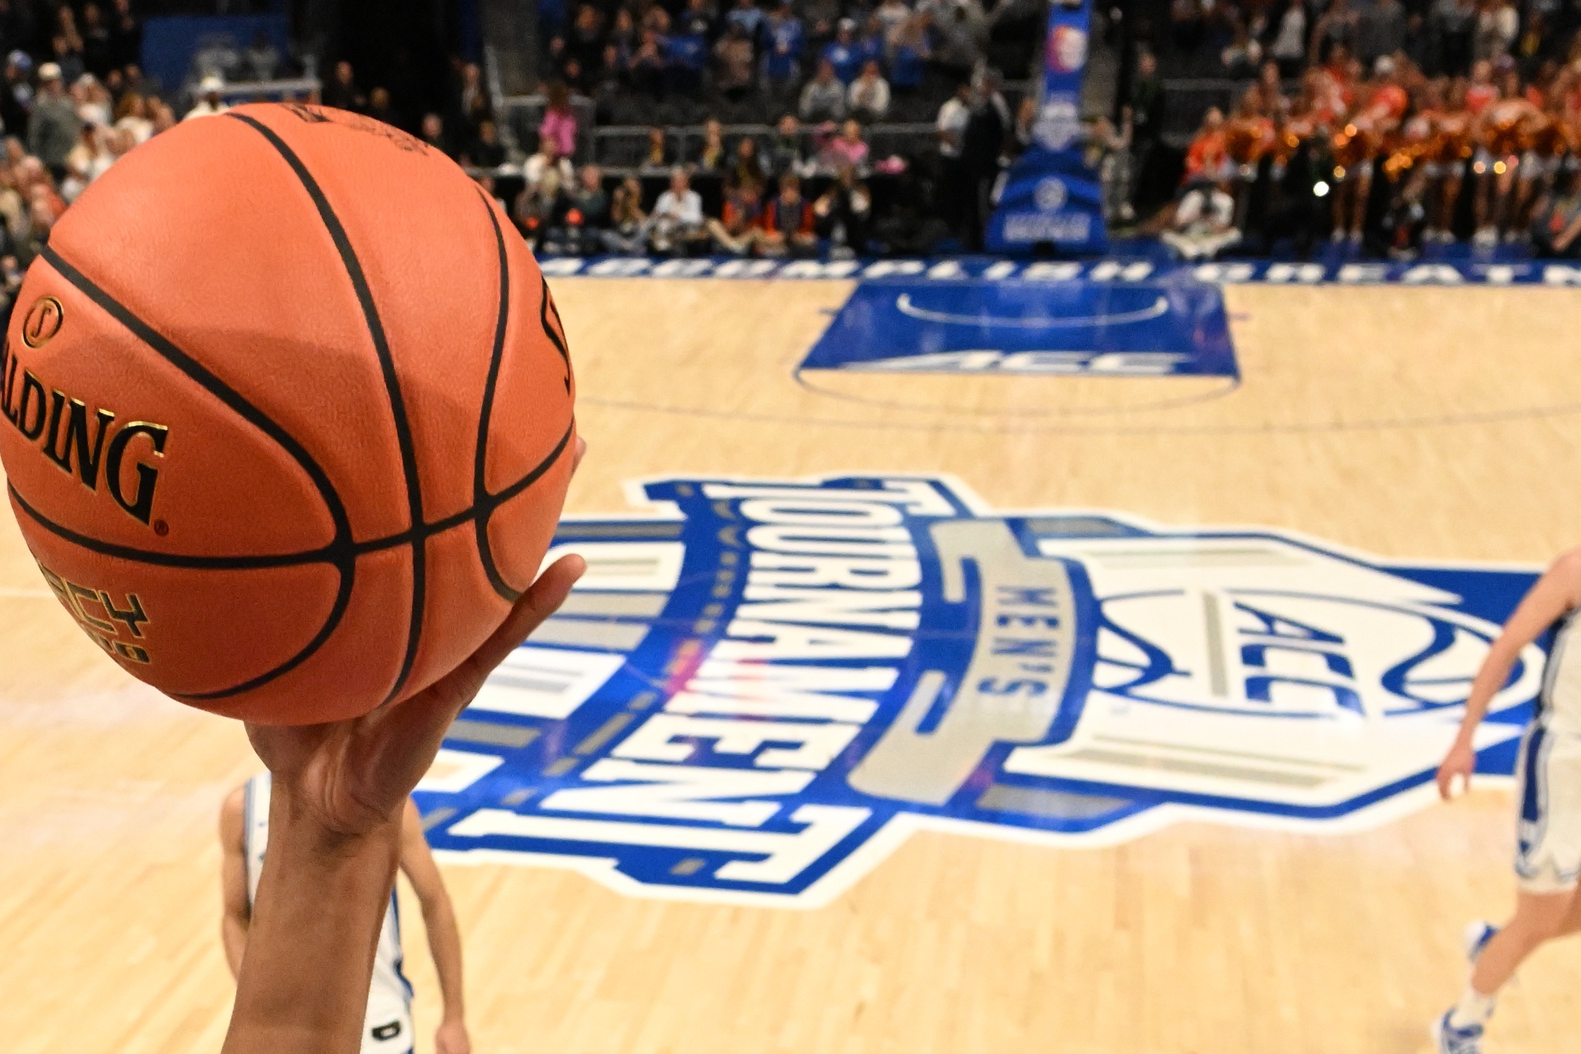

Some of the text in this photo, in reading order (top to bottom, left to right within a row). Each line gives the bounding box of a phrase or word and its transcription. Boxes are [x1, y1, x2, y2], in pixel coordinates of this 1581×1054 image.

[0, 340, 169, 527] LDING
[450, 478, 955, 884] TOURNAMENT
[977, 585, 1063, 702] MEN'S
[1232, 601, 1364, 716] ACC
